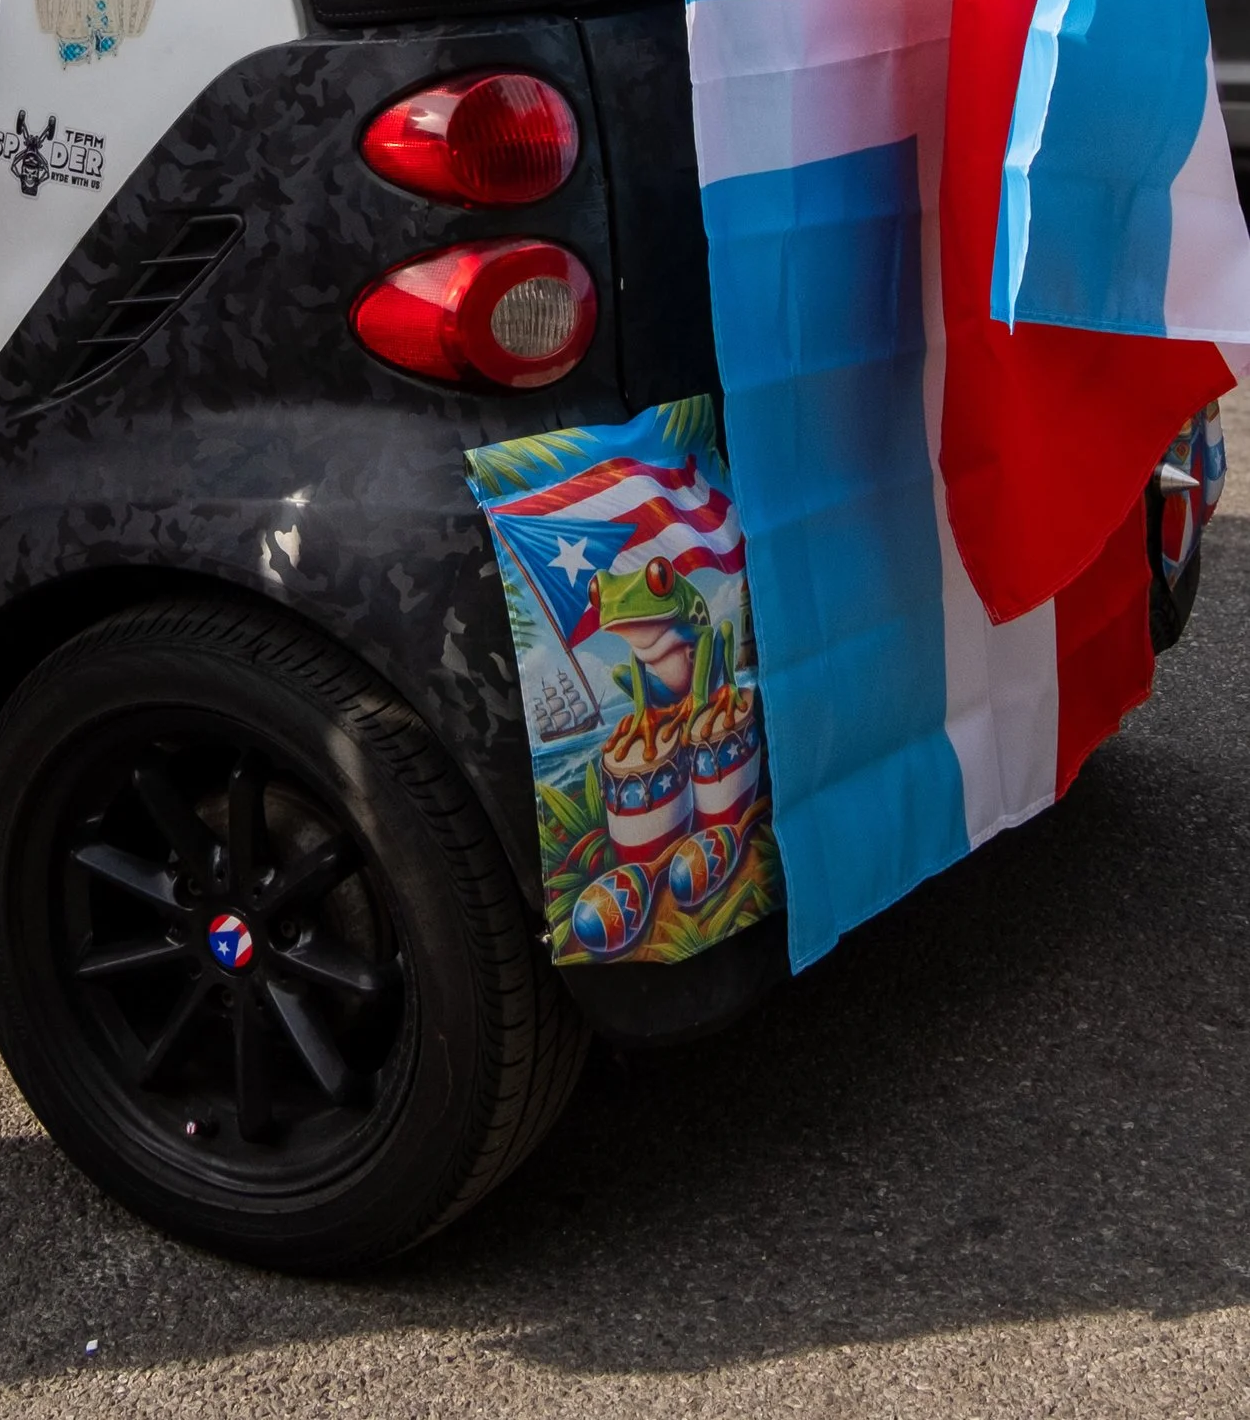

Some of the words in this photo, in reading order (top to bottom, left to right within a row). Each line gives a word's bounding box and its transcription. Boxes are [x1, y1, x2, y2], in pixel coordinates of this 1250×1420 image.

[65, 129, 104, 149] TEAM
[51, 172, 69, 183] RYDE
[71, 175, 88, 187] WITH
[91, 180, 100, 189] US
